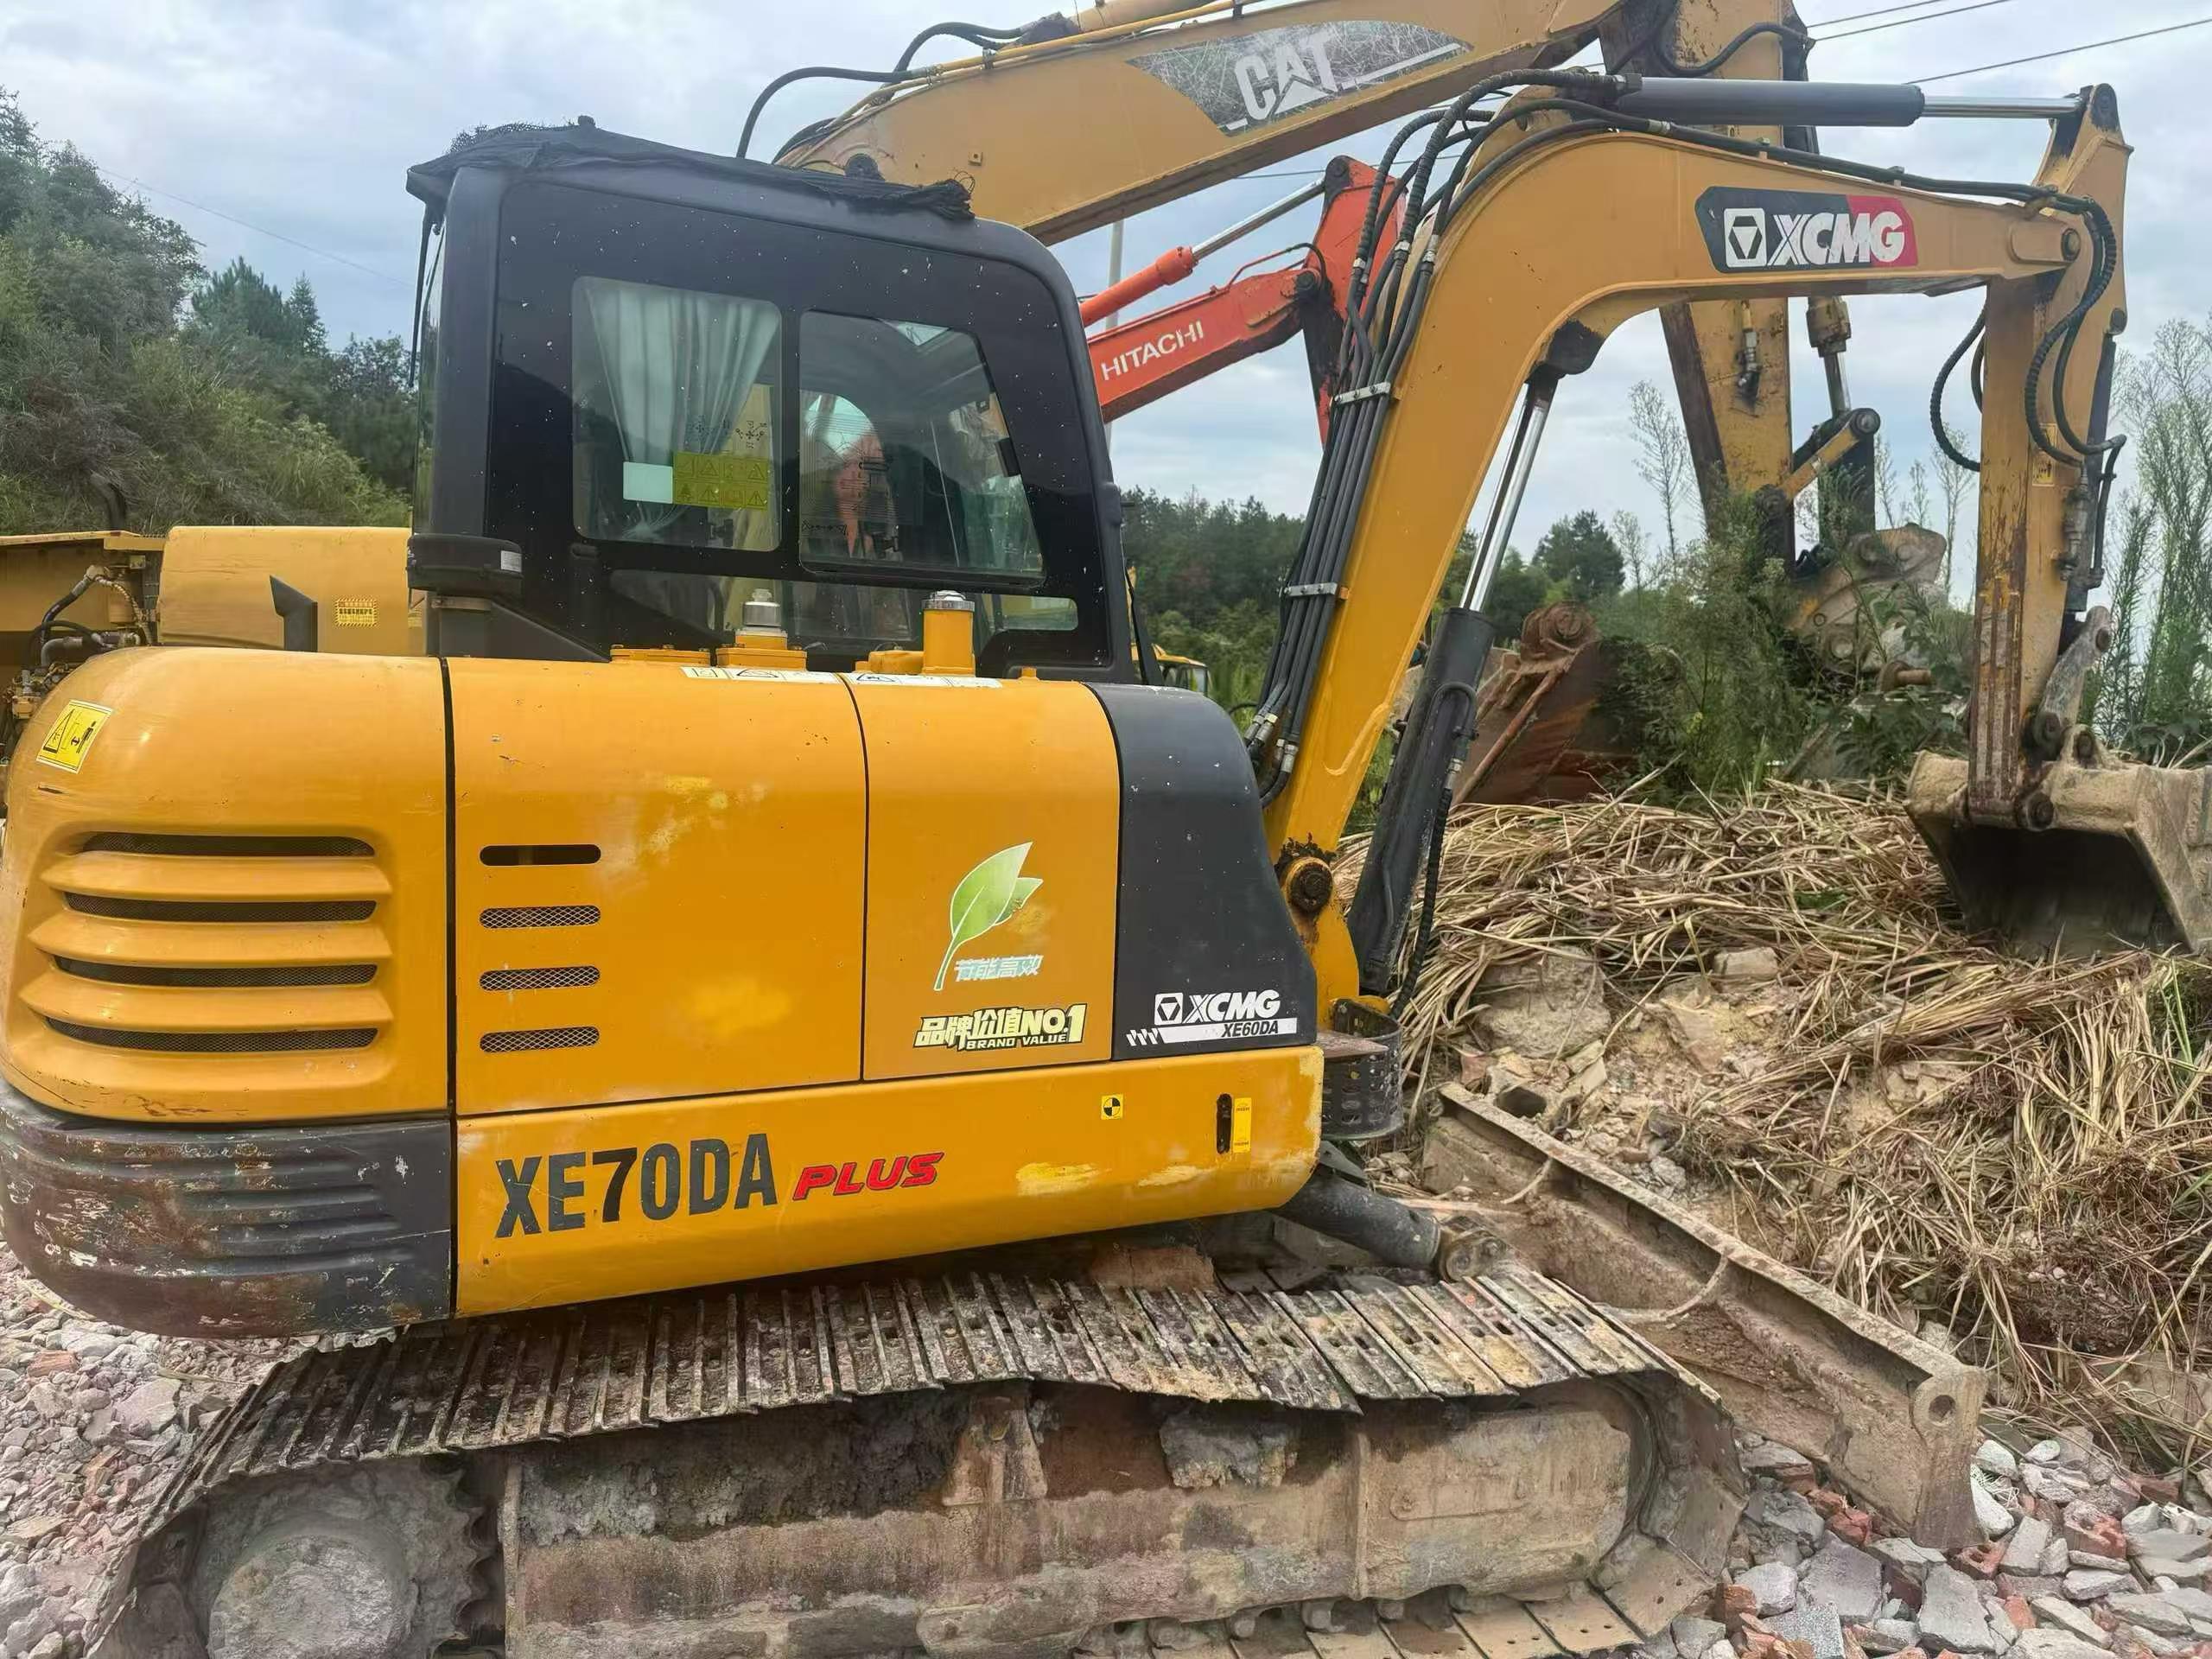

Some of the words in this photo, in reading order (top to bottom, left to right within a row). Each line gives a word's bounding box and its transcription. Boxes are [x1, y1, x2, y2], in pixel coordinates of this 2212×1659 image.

[1234, 31, 1338, 120] CAT
[1767, 212, 1904, 265] XCMG
[1101, 321, 1204, 381] HITACHI
[954, 954, 1044, 982] 节能高效
[1182, 989, 1281, 1024] XCMG
[967, 1037, 1015, 1050] BRAND
[1022, 1034, 1067, 1046] VALUE
[1221, 1020, 1278, 1038] XE60DA
[494, 1133, 778, 1238] XE70DA
[792, 1152, 944, 1201] PLUS
